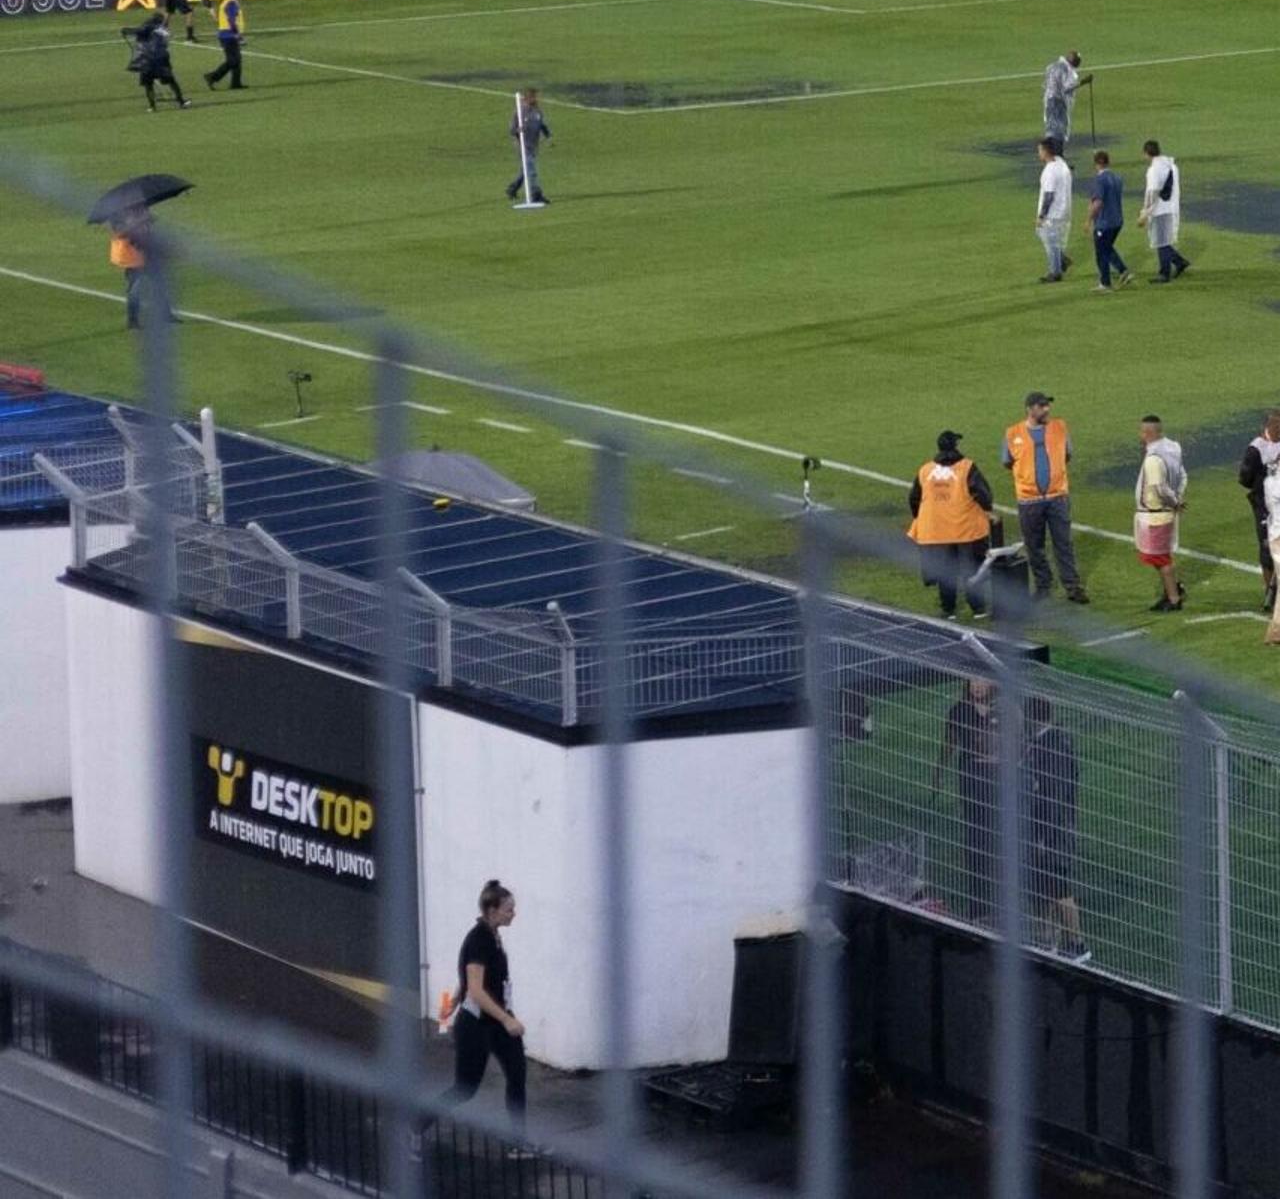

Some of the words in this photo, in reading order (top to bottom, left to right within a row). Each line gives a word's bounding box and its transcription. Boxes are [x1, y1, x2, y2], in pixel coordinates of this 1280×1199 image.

[250, 769, 374, 839] DESKTOP
[209, 810, 219, 830] A
[220, 813, 277, 851] INTERNET
[279, 832, 304, 858] QUE
[305, 841, 334, 868] JOGA
[336, 849, 375, 880] JUNTO
